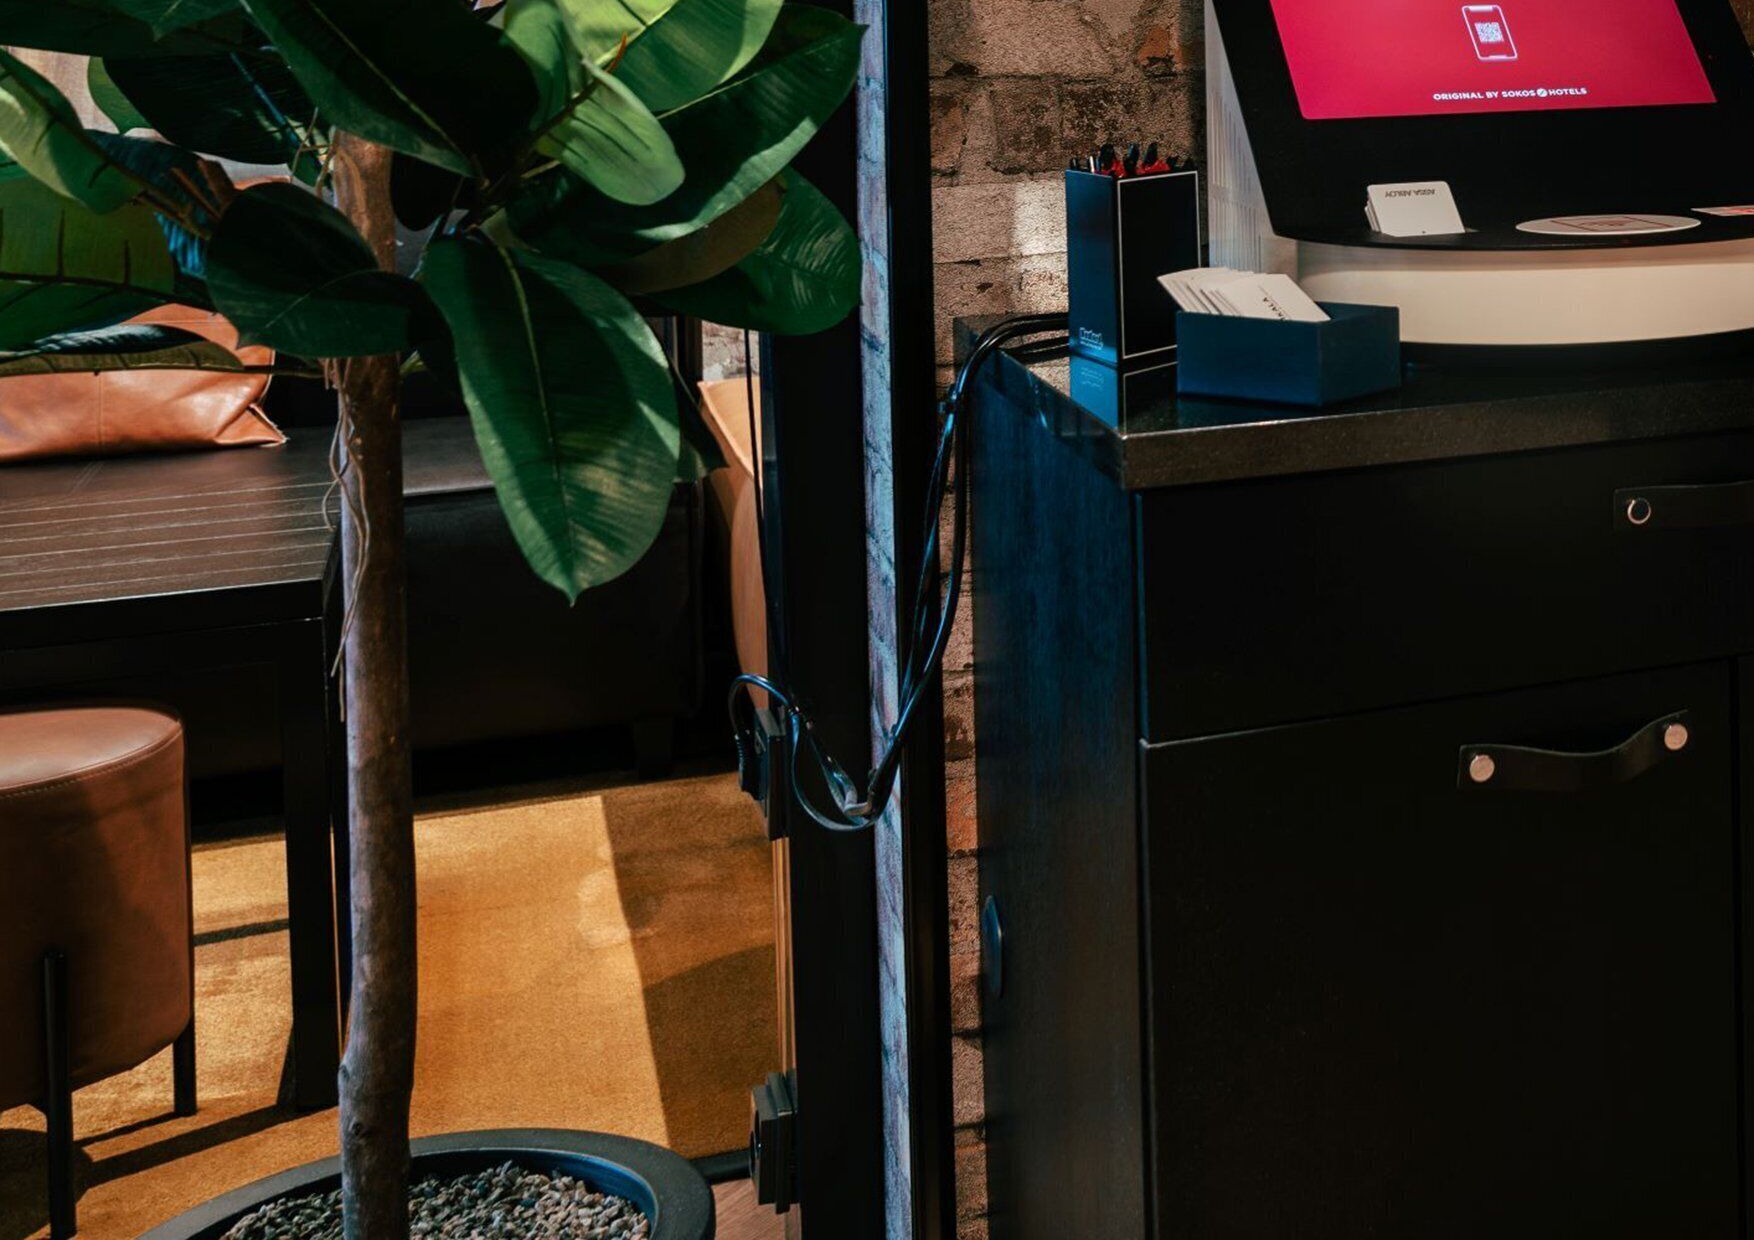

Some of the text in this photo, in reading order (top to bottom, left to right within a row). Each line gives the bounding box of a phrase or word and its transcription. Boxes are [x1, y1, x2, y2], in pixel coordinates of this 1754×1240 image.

[1433, 87, 1588, 101] ORIGINAL BY SOKOS HOTELS
